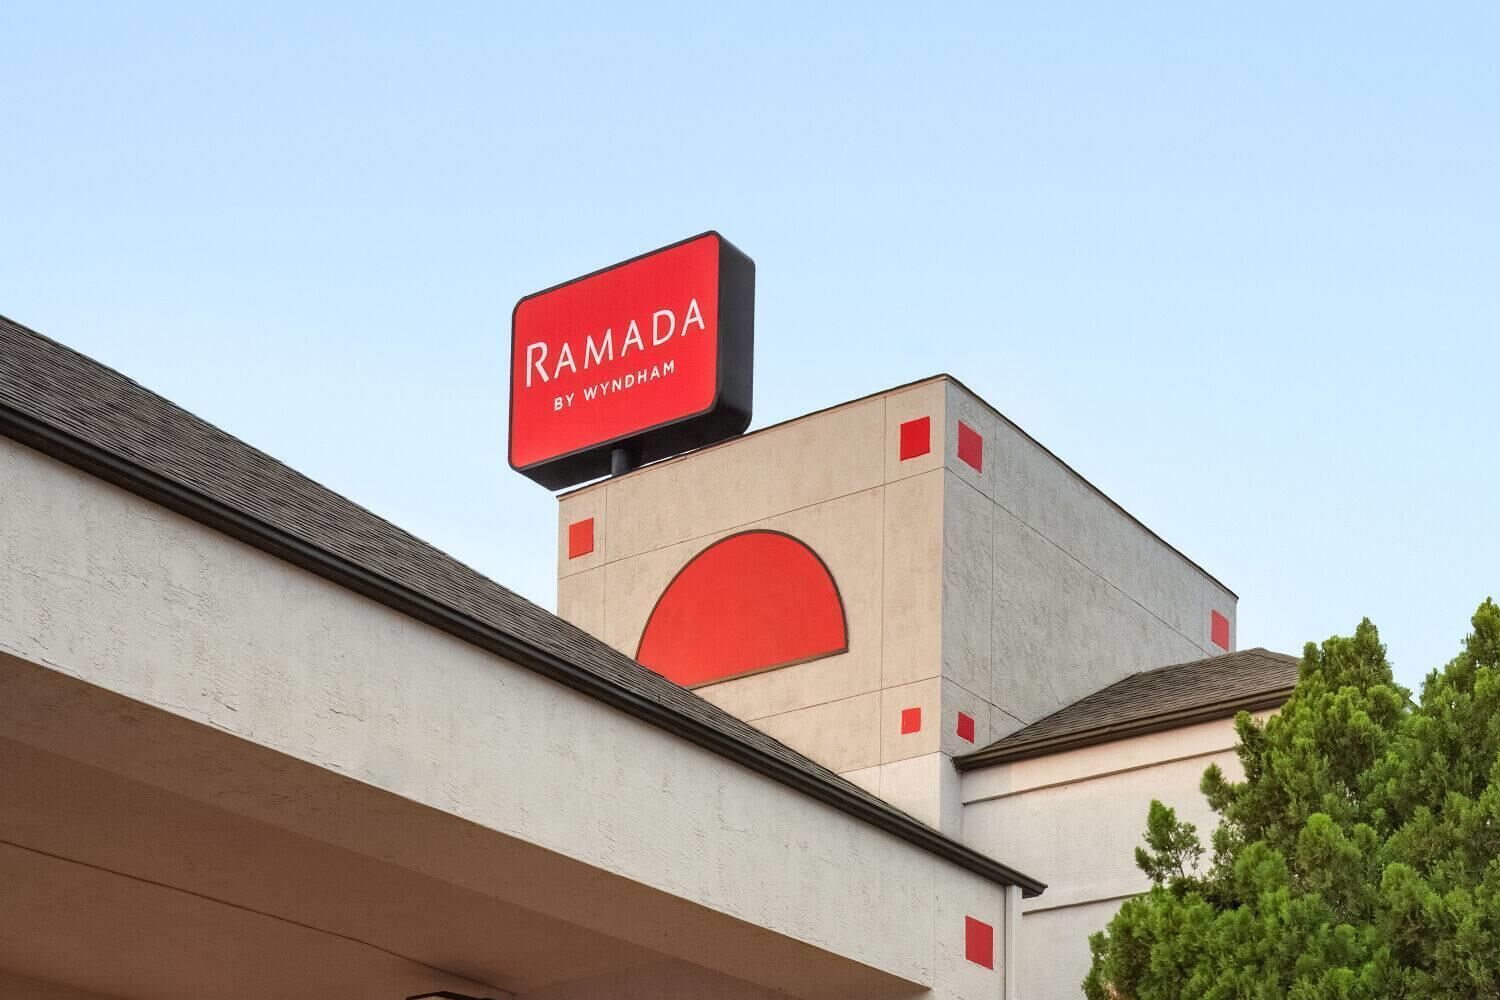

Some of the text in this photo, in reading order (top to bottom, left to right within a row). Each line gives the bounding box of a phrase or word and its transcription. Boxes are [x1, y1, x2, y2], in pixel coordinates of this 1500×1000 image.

[526, 298, 705, 387] RAMADA
[553, 360, 675, 411] BY WYNDHAM
